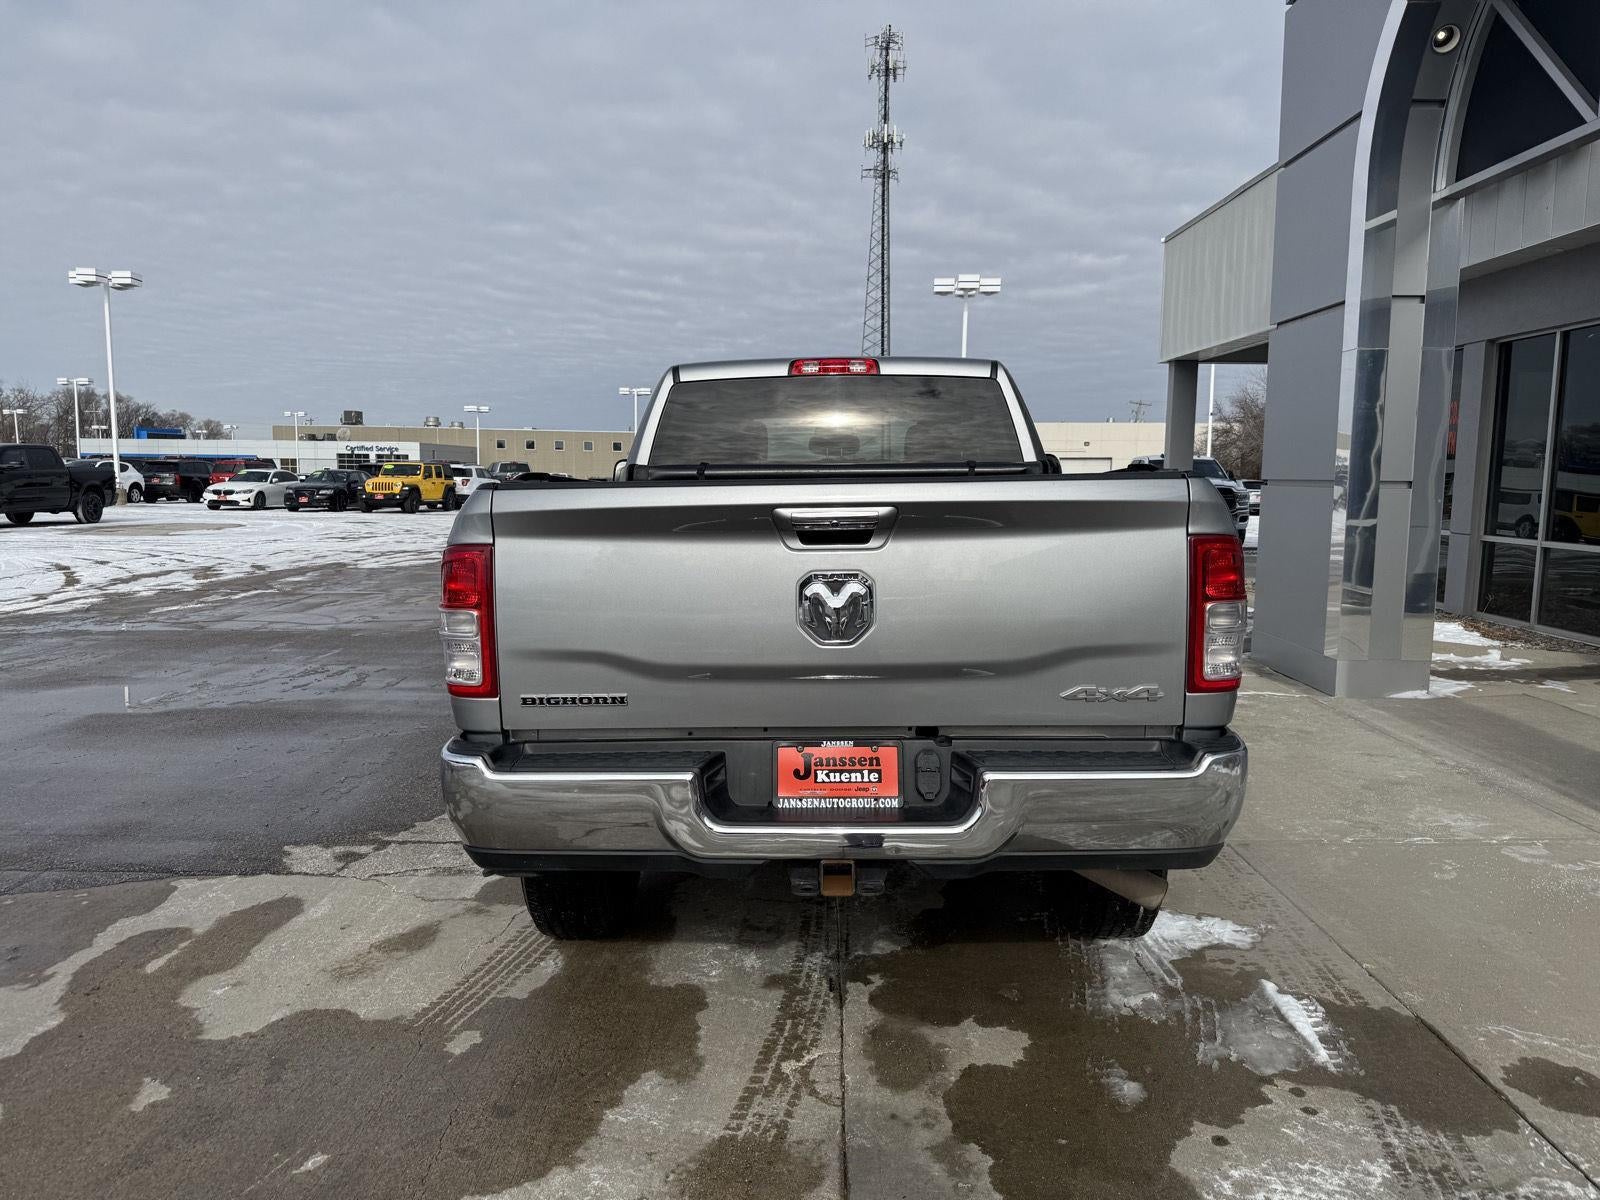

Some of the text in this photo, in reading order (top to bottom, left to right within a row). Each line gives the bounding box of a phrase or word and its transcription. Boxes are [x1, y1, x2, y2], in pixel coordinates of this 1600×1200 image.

[813, 573, 861, 581] RAM
[520, 693, 628, 707] BIGHORN
[1059, 684, 1165, 703] 4x4
[793, 752, 882, 781] Janssen
[816, 770, 879, 783] Kuenle
[777, 798, 899, 809] JANSSENAUTOGROUP.COM
